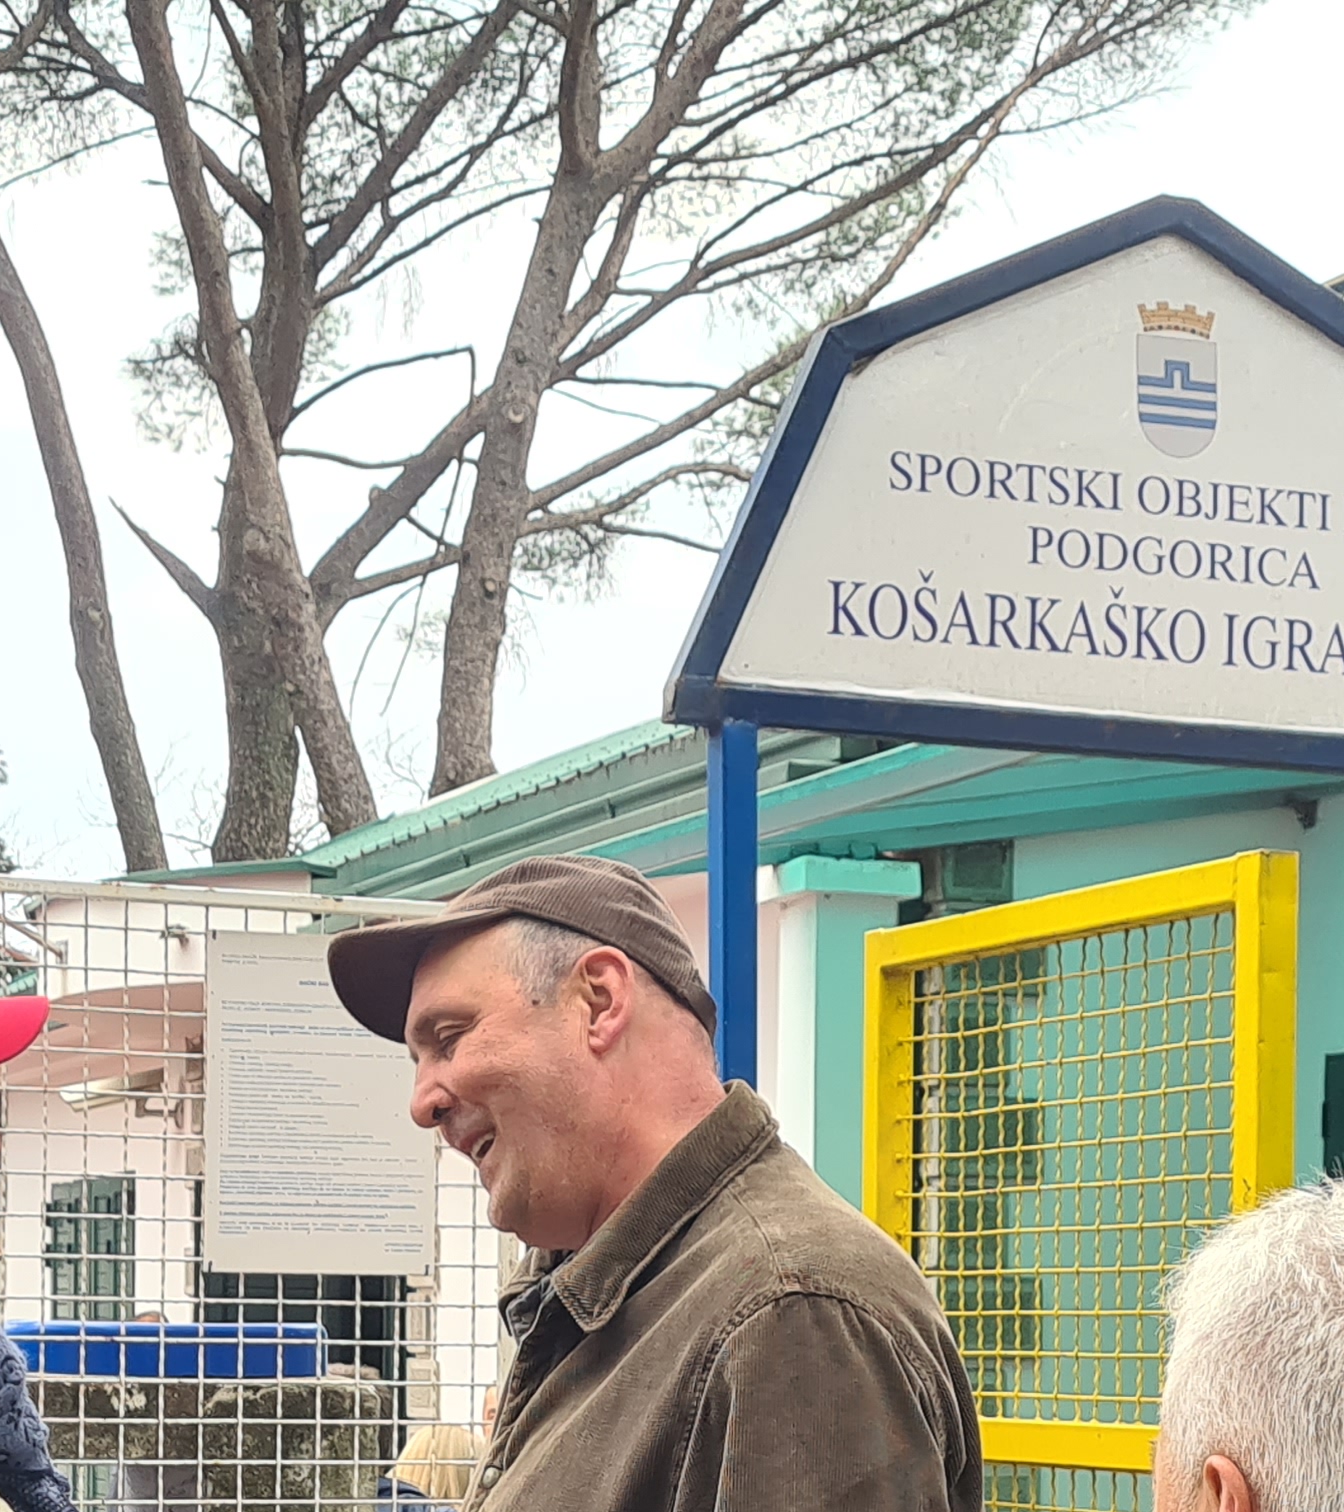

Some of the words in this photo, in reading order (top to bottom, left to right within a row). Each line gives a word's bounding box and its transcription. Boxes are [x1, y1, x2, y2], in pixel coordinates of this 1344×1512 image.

[888, 451, 1121, 511] SPORTSKI
[1136, 475, 1330, 532] OBJEKTI
[1028, 525, 1320, 590] PODGORICA
[827, 570, 1207, 664] KOŠARKAŠKO
